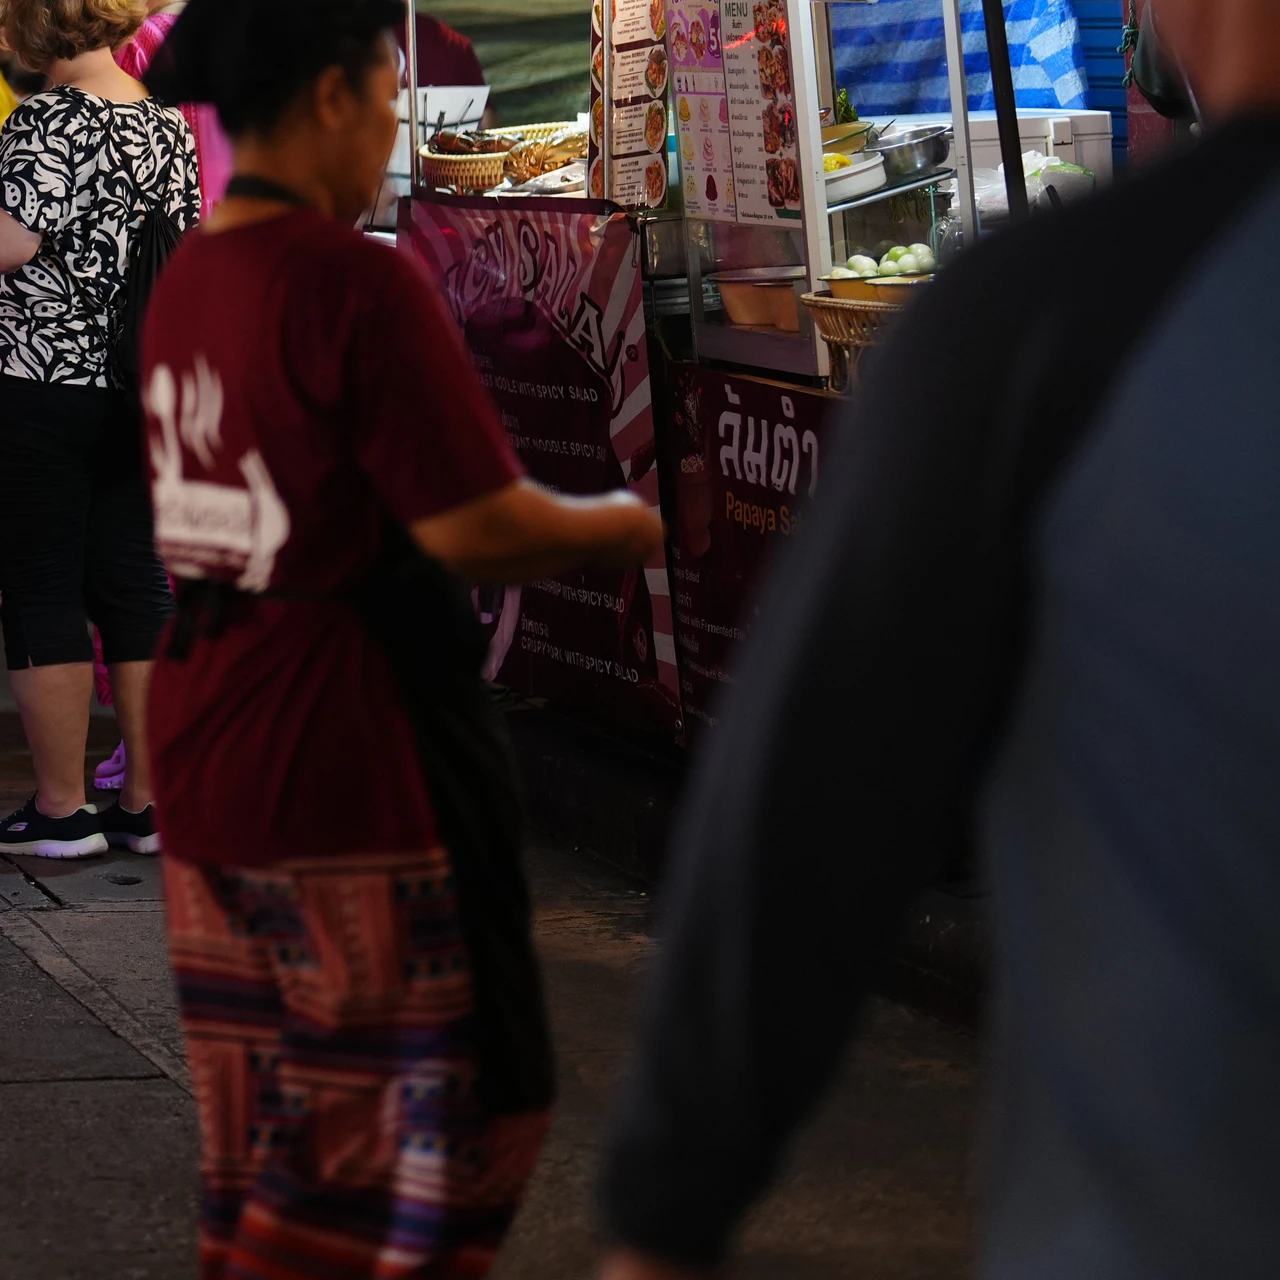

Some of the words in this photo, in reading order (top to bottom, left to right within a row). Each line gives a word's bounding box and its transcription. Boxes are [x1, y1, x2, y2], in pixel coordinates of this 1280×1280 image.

[724, 2, 748, 18] MENU
[536, 384, 565, 400] SPICY
[568, 385, 599, 403] SALAD
[532, 437, 570, 455] NOODLE
[569, 441, 595, 459] SPICY
[717, 383, 819, 500] ส้มตำ
[724, 489, 776, 535] Papaya
[577, 589, 603, 607] SPICY
[603, 594, 625, 613] SALAD
[701, 618, 733, 638] Fermented
[521, 635, 547, 656] CRISPY
[564, 649, 585, 667] WITH
[585, 655, 612, 675] SPICY
[614, 662, 639, 684] SALAD
